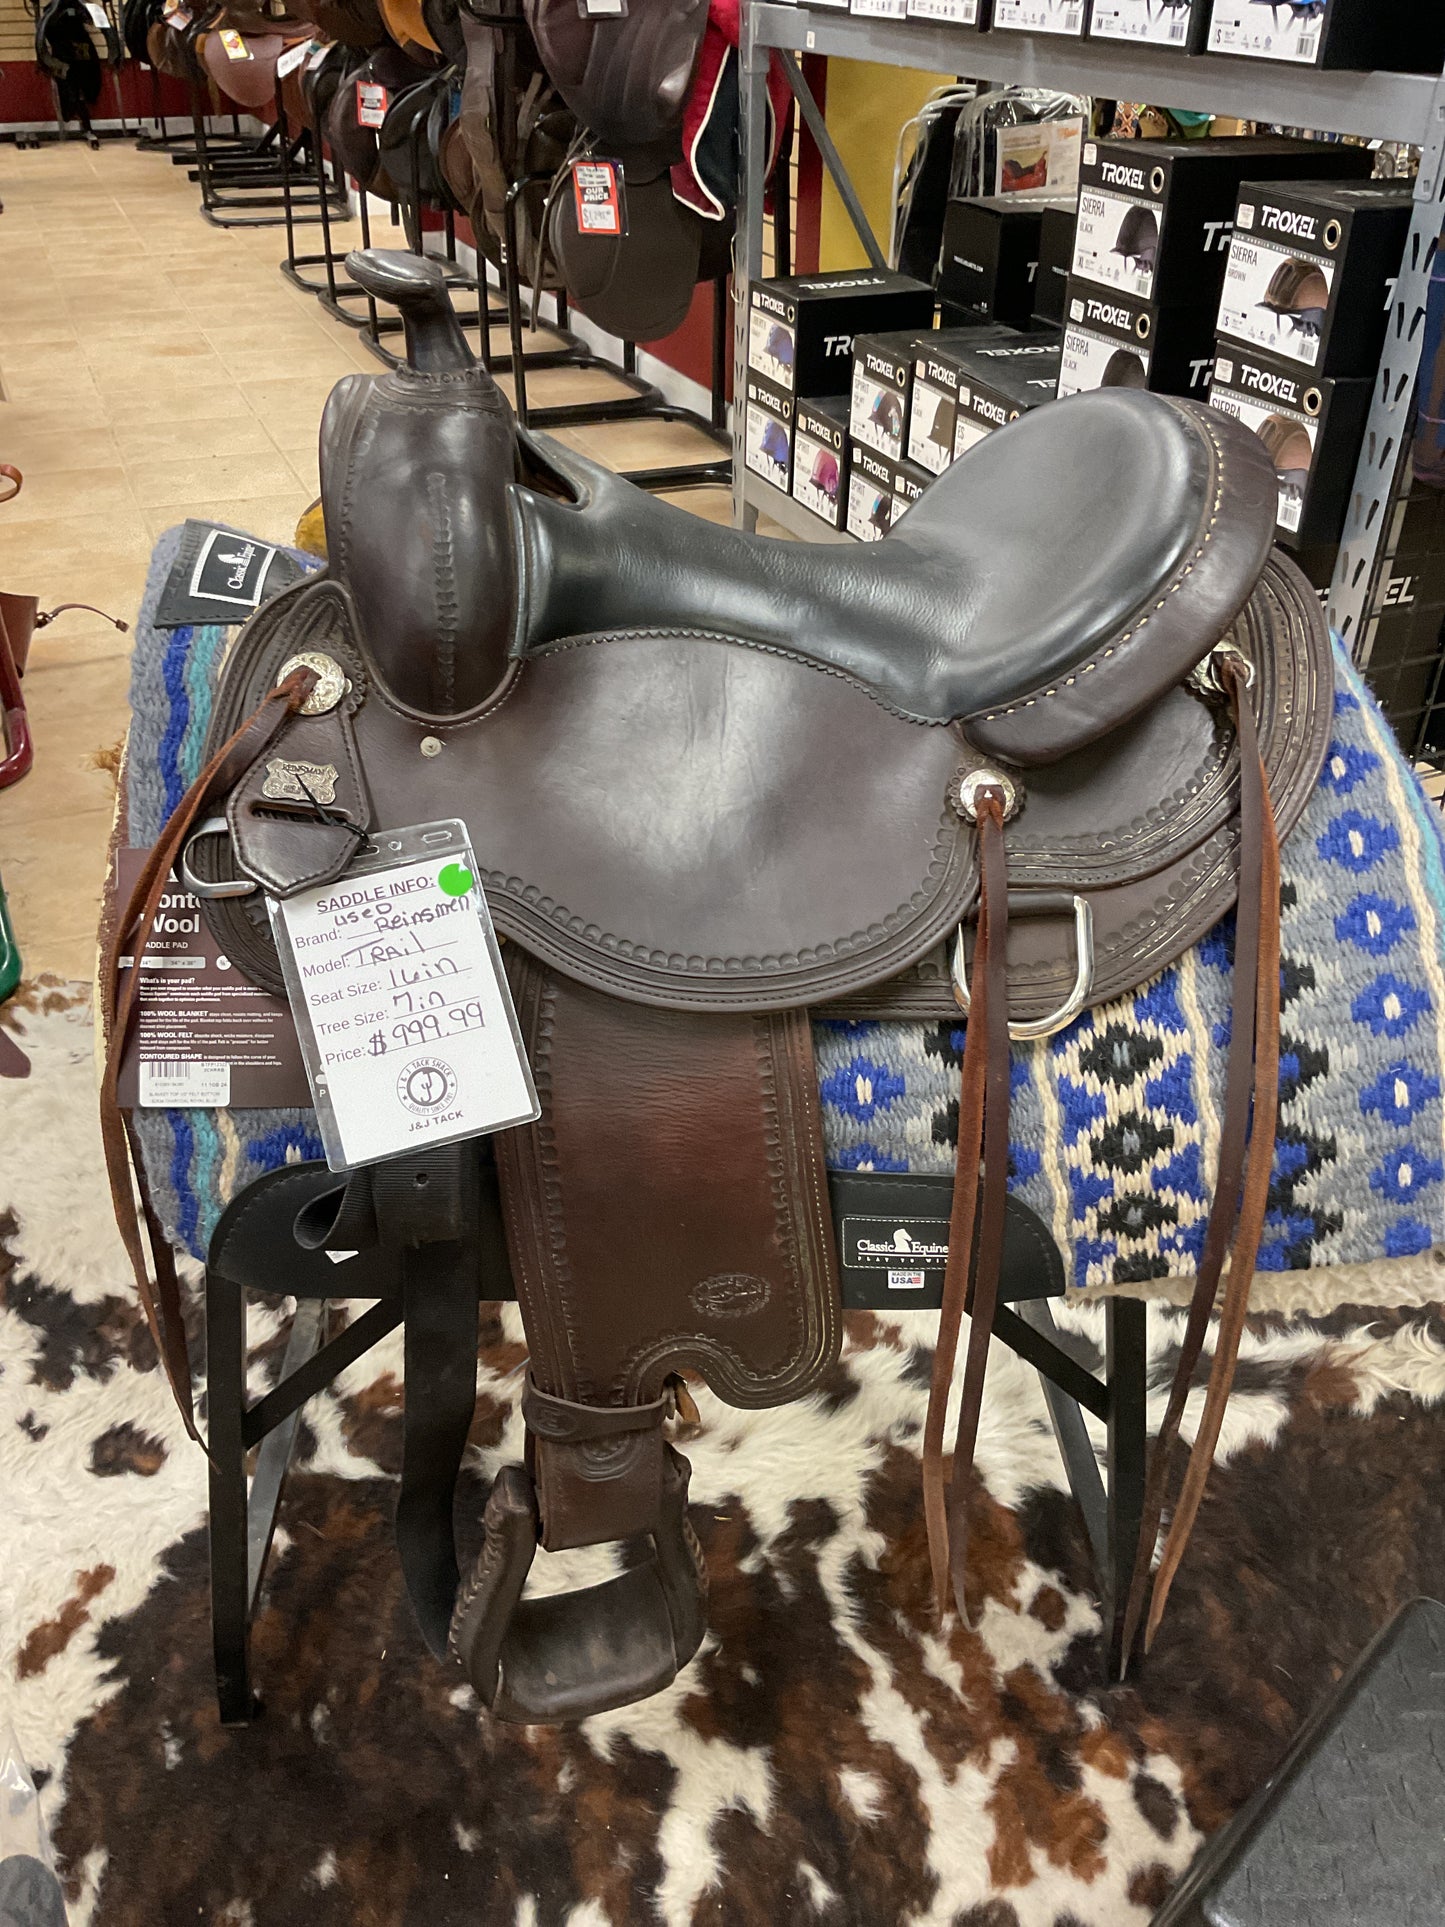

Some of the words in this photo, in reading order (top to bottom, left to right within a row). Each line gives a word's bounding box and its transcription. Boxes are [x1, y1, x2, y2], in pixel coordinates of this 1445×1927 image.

[1101, 162, 1145, 190] TROXEL
[584, 193, 609, 202] PRICE
[586, 187, 603, 195] OUR
[1082, 197, 1105, 218] SIERRA
[1079, 221, 1093, 234] BLACK
[1261, 205, 1316, 240] TROXEL
[1230, 244, 1258, 266] SIERRA
[799, 278, 886, 290] TROXEL
[1227, 267, 1246, 282] BROWN
[760, 293, 786, 317] TROXEL
[1086, 299, 1132, 331] TROXEL
[824, 335, 854, 357] TR
[1065, 335, 1089, 357] SIERRA
[866, 353, 894, 380] TROXEL
[927, 360, 957, 389] TROXEL
[1241, 364, 1298, 404] TROXEL
[757, 387, 782, 412] TROXEL
[972, 395, 1007, 426] TROXEL
[806, 417, 832, 442] TROXEL
[957, 425, 965, 440] ES
[863, 455, 890, 483] TROXEL
[317, 886, 386, 913] SADDLE
[389, 876, 435, 897] INFO:
[145, 941, 170, 949] ADDLE
[172, 941, 189, 949] PAD
[295, 928, 342, 949] Brand:
[302, 956, 350, 978] Model:
[180, 977, 195, 985] pad?
[310, 990, 344, 1007] Seat
[347, 979, 382, 998] Size:
[317, 1017, 350, 1036] Tree
[354, 1009, 389, 1027] Size:
[325, 1044, 368, 1066] Price:
[412, 1059, 430, 1070] TACK
[432, 1059, 452, 1077] SHACK
[408, 1119, 430, 1132] J&J
[432, 1110, 464, 1125] TACK
[857, 1239, 895, 1253] Classic
[911, 1241, 949, 1256] Equine
